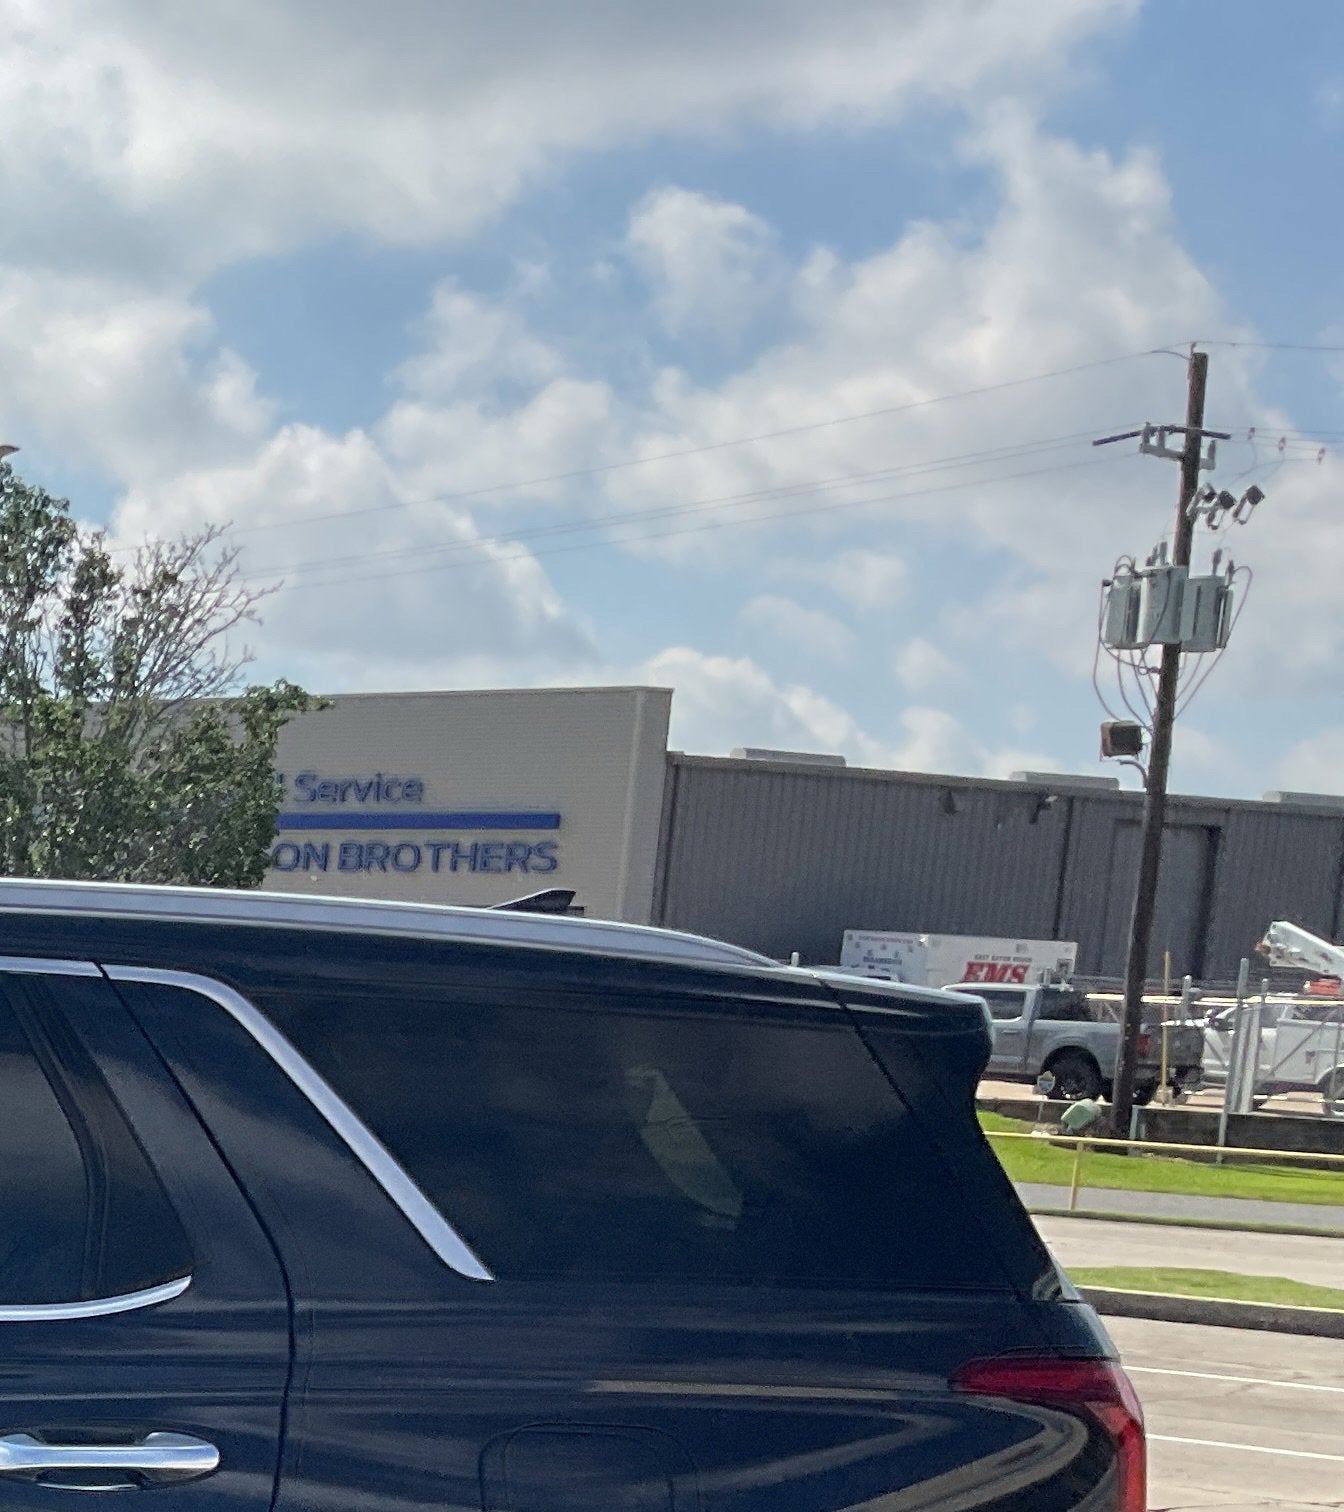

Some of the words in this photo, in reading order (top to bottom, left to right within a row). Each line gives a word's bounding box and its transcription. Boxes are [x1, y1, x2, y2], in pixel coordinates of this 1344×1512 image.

[295, 770, 425, 803] Service
[336, 839, 559, 874] BROTHERS
[960, 961, 1031, 983] EMS
